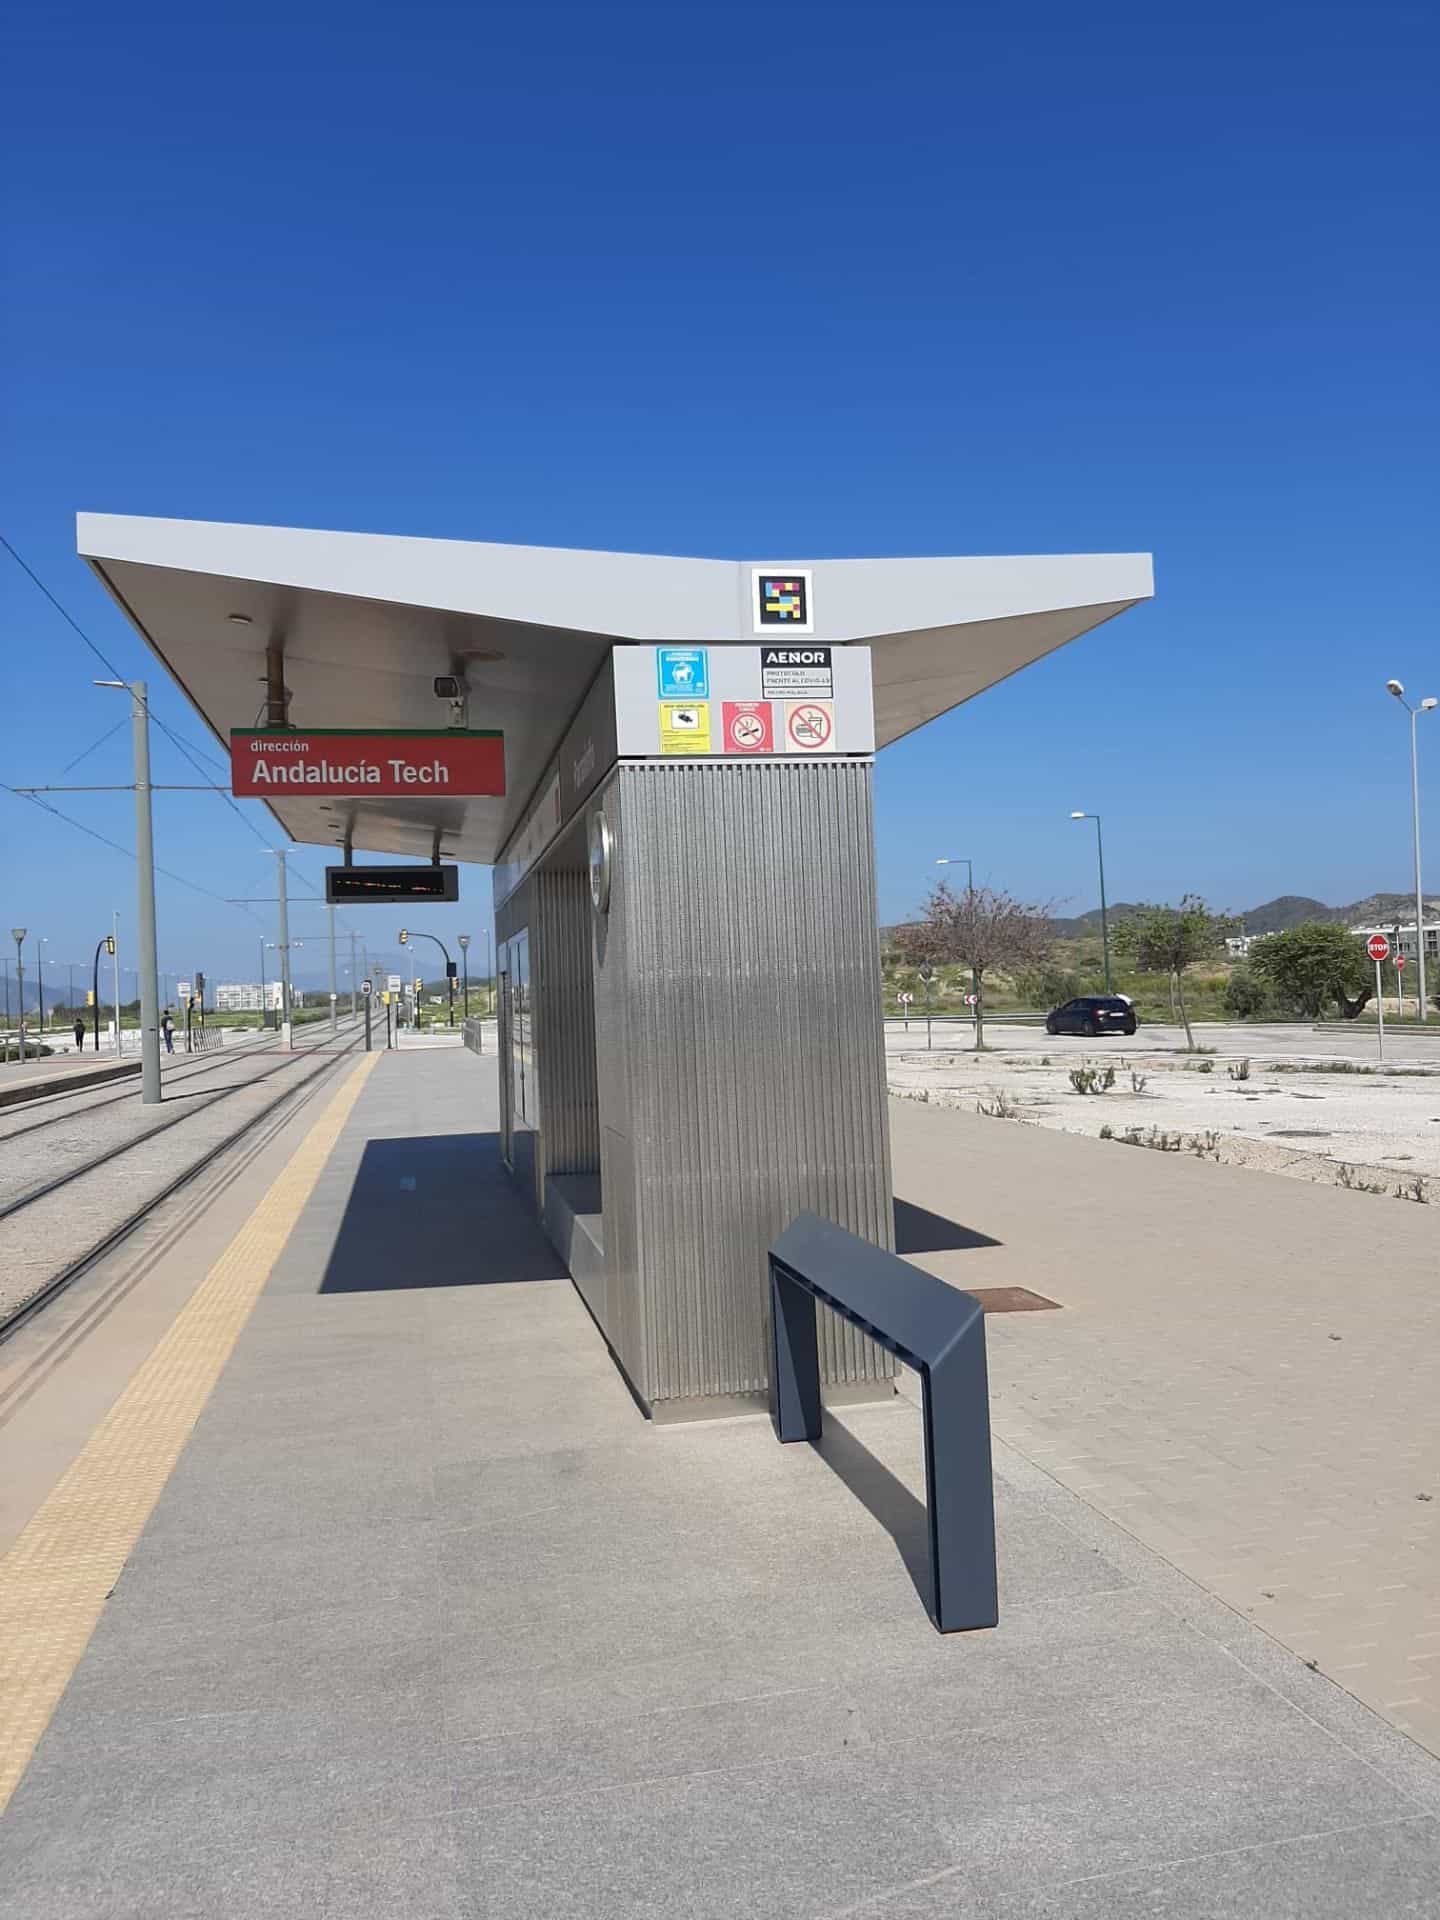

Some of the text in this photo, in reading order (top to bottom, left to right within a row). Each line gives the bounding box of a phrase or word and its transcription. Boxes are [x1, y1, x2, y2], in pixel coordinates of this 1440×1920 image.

[766, 652, 825, 664] AENOR
[250, 739, 309, 752] dirección
[252, 759, 449, 783] Andalucía Tech
[1369, 943, 1388, 952] STOP
